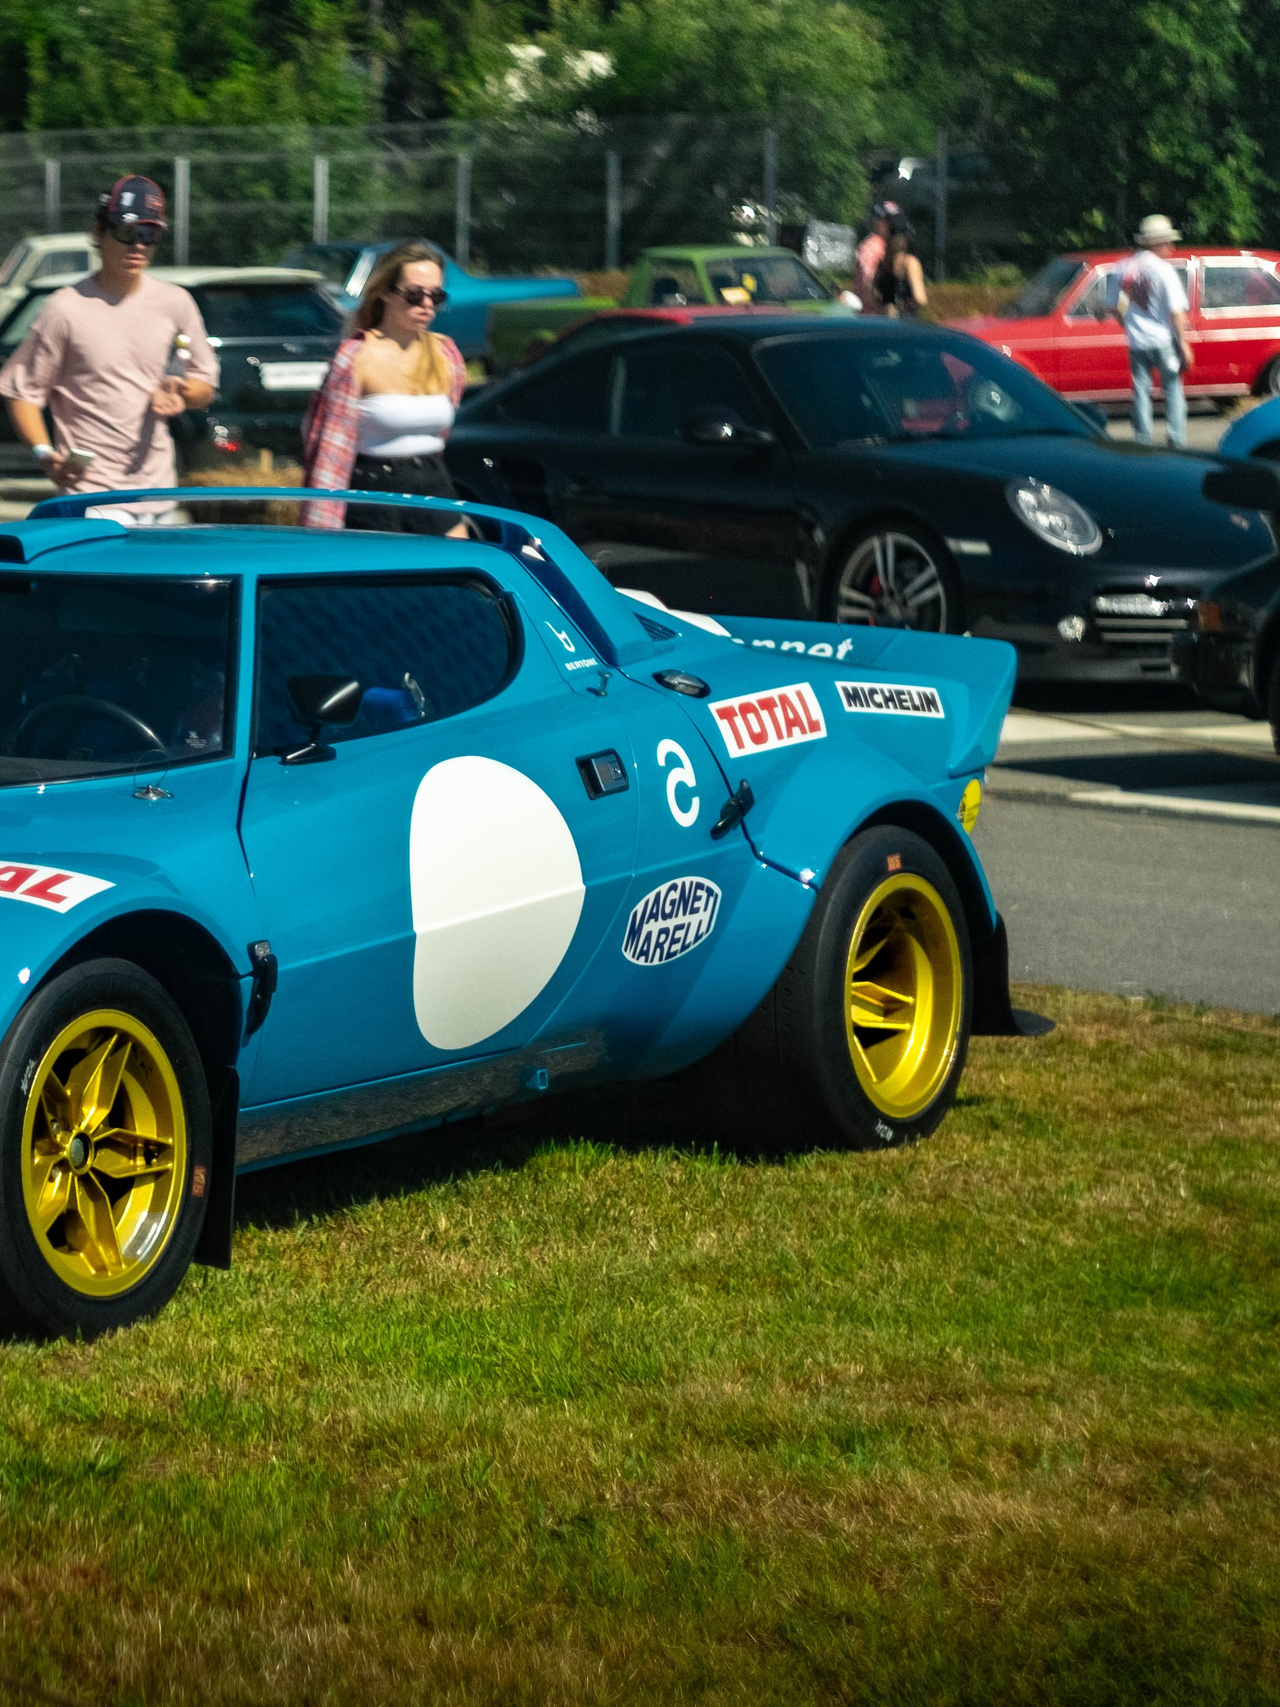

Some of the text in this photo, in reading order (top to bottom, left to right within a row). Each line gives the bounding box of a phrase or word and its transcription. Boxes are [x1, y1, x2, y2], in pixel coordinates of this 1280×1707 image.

[565, 657, 599, 671] BERTONE
[715, 689, 821, 750] TOTAL
[840, 685, 940, 714] MICHELIN
[624, 910, 715, 964] MARELLI
[625, 880, 718, 940] MAGNETI
